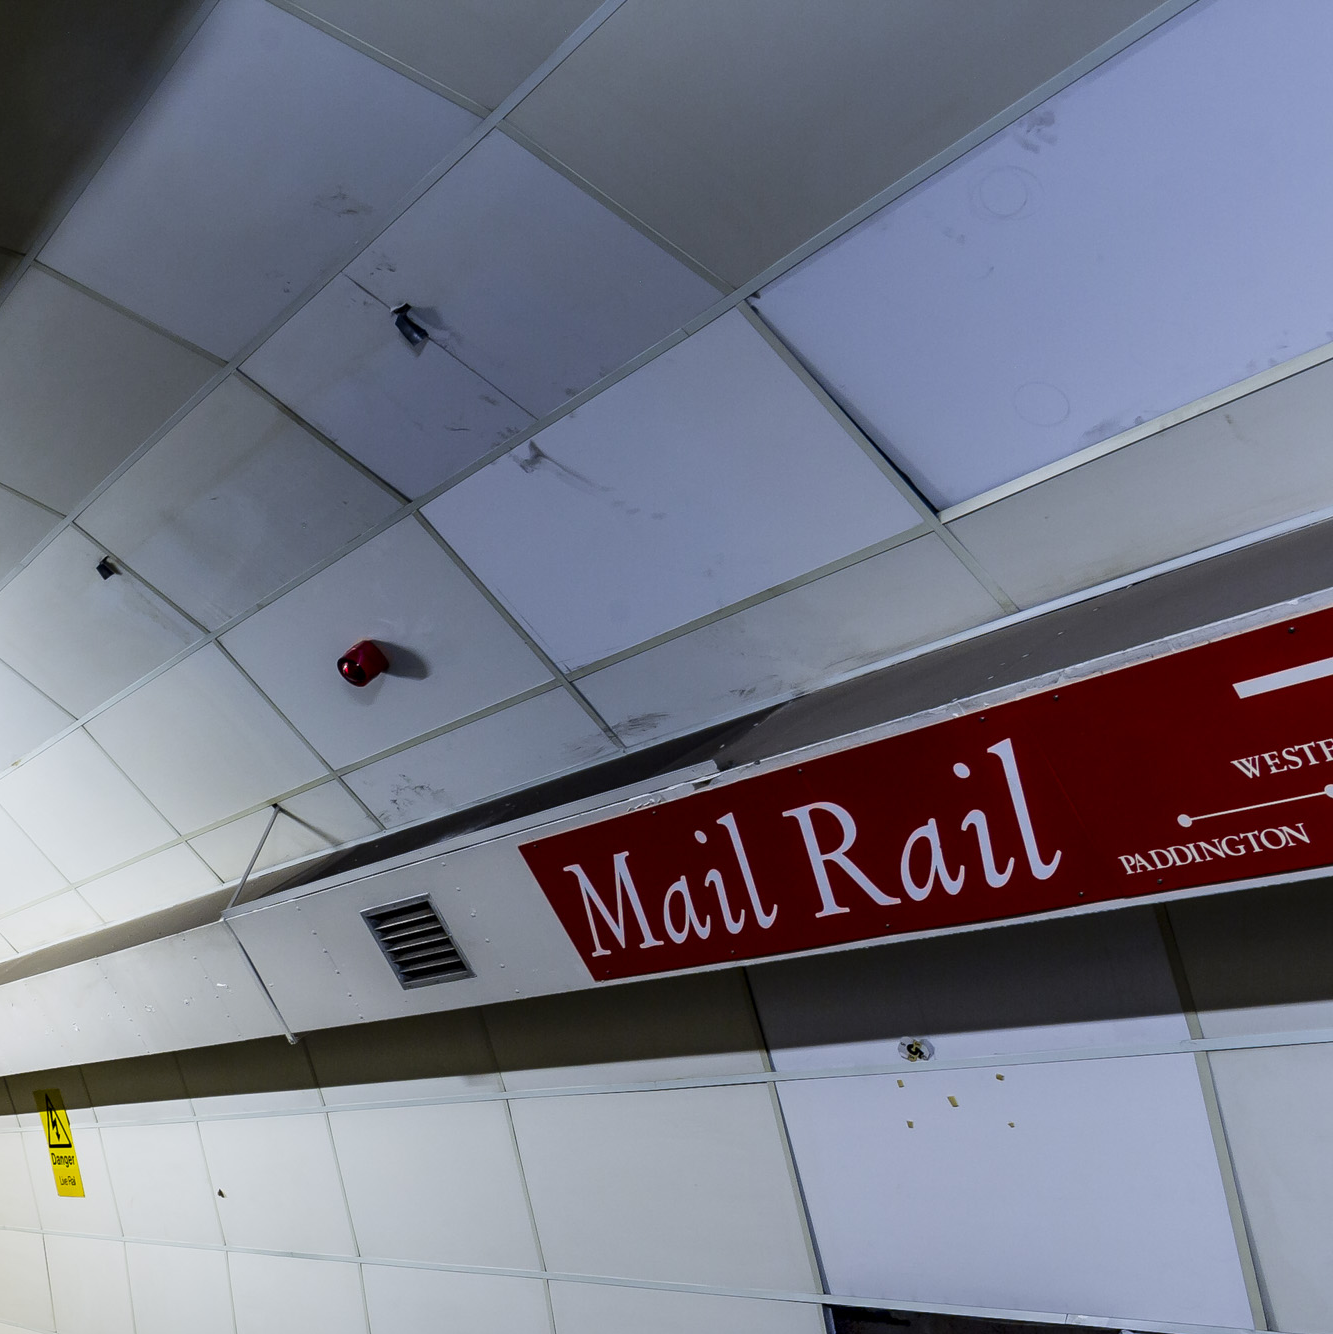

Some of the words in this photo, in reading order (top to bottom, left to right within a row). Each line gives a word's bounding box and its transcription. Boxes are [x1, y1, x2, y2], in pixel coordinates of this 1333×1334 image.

[562, 812, 778, 957] Mail
[782, 738, 1062, 918] Rail
[1118, 823, 1311, 875] PADDINGTON
[51, 1152, 75, 1168] Danger
